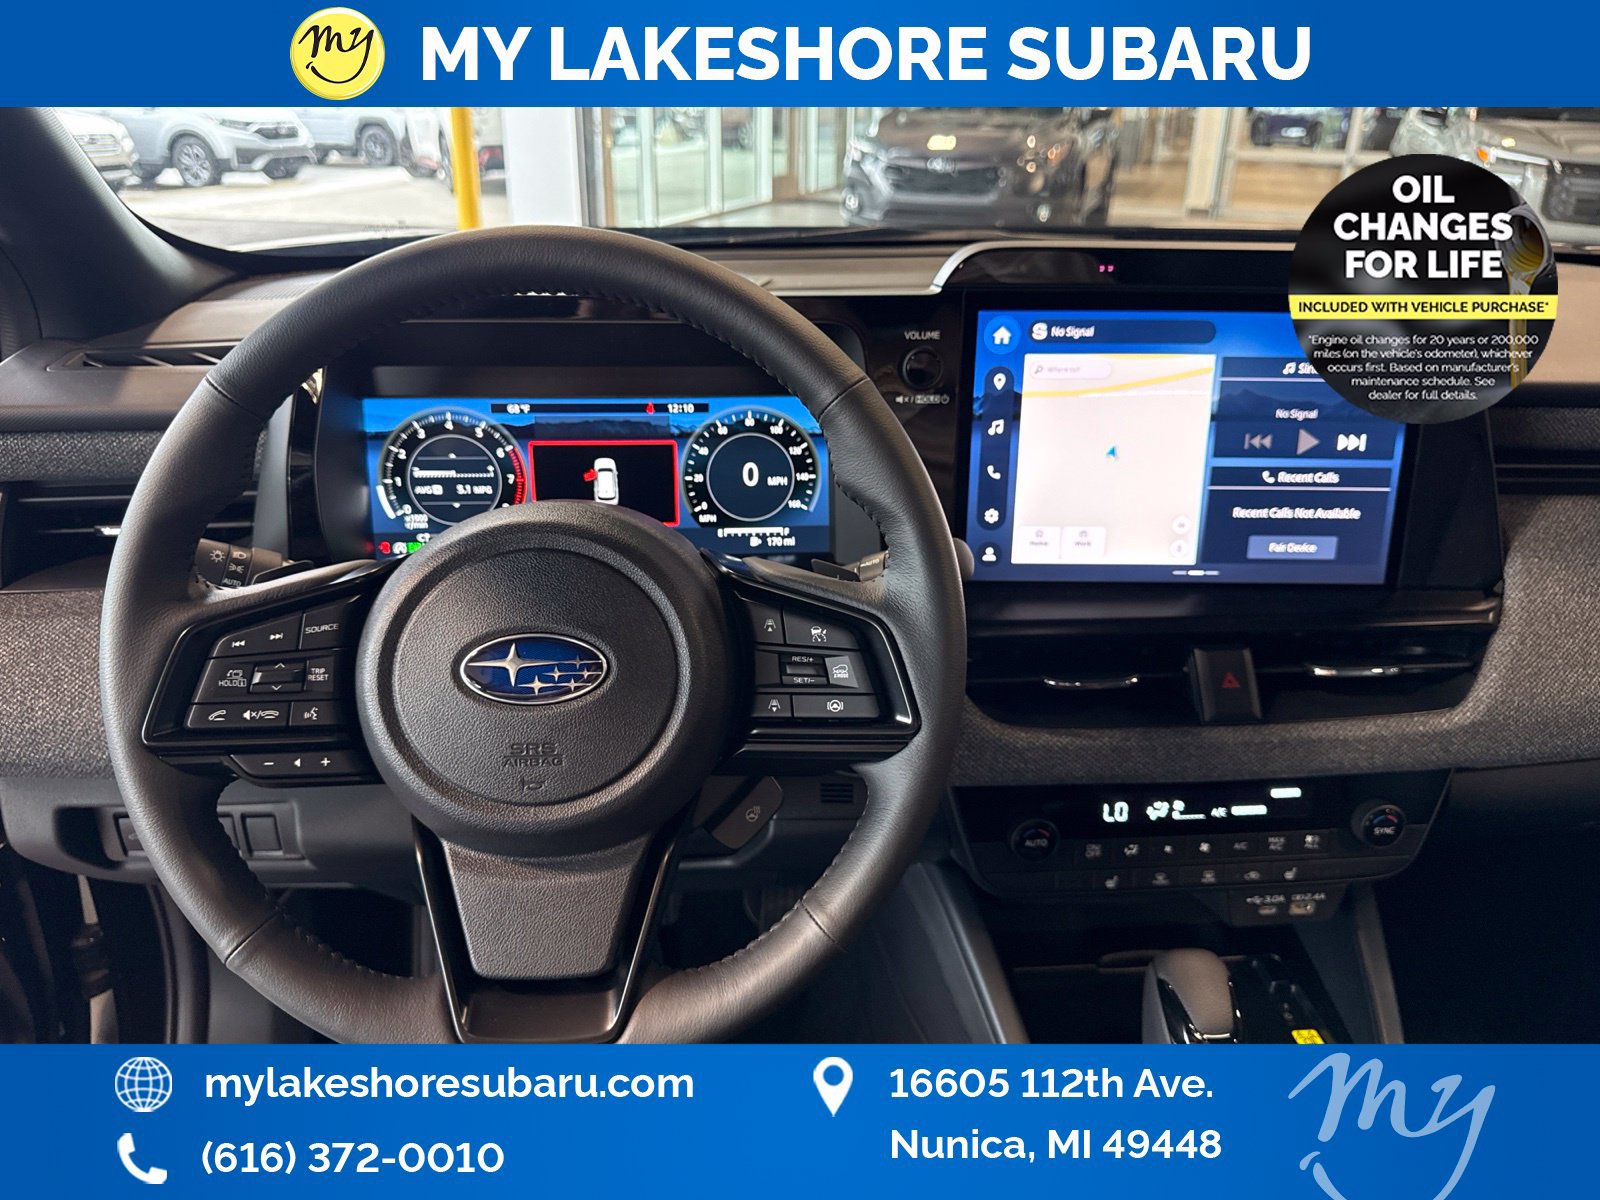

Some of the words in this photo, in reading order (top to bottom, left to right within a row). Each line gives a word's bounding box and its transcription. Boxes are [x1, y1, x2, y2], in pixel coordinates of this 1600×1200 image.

[904, 330, 941, 340] VOLUME
[1051, 326, 1065, 338] No
[1066, 326, 1095, 340] Signal
[667, 403, 695, 414] 12:10
[1275, 408, 1289, 419] No
[1289, 408, 1319, 421] Signal
[769, 426, 784, 435] 100
[397, 448, 407, 460] 2
[496, 447, 505, 458] 6
[788, 446, 802, 456] 120
[506, 473, 515, 484] 7
[693, 473, 704, 483] 20
[742, 461, 760, 487] 0
[767, 476, 788, 486] MPH
[795, 472, 810, 482] 140
[1277, 471, 1314, 483] Recent
[1314, 471, 1340, 484] Calls
[472, 485, 493, 495] MPG
[402, 504, 412, 515] 0
[1232, 506, 1269, 518] Recent
[1268, 506, 1294, 519] Calls
[1294, 507, 1315, 519] Not
[1314, 507, 1361, 520] Available
[698, 514, 717, 523] MPH
[767, 537, 783, 547] 170
[783, 536, 796, 547] mi
[222, 577, 243, 587] AUTO
[305, 623, 339, 634] SOURCE
[311, 667, 326, 675] TRIP
[218, 679, 237, 687] HOLD
[510, 742, 559, 756] SRS
[502, 756, 565, 767] AIRBAG
[1102, 801, 1130, 823] LO
[1373, 827, 1398, 836] SYNC
[1024, 838, 1049, 847] AUTO
